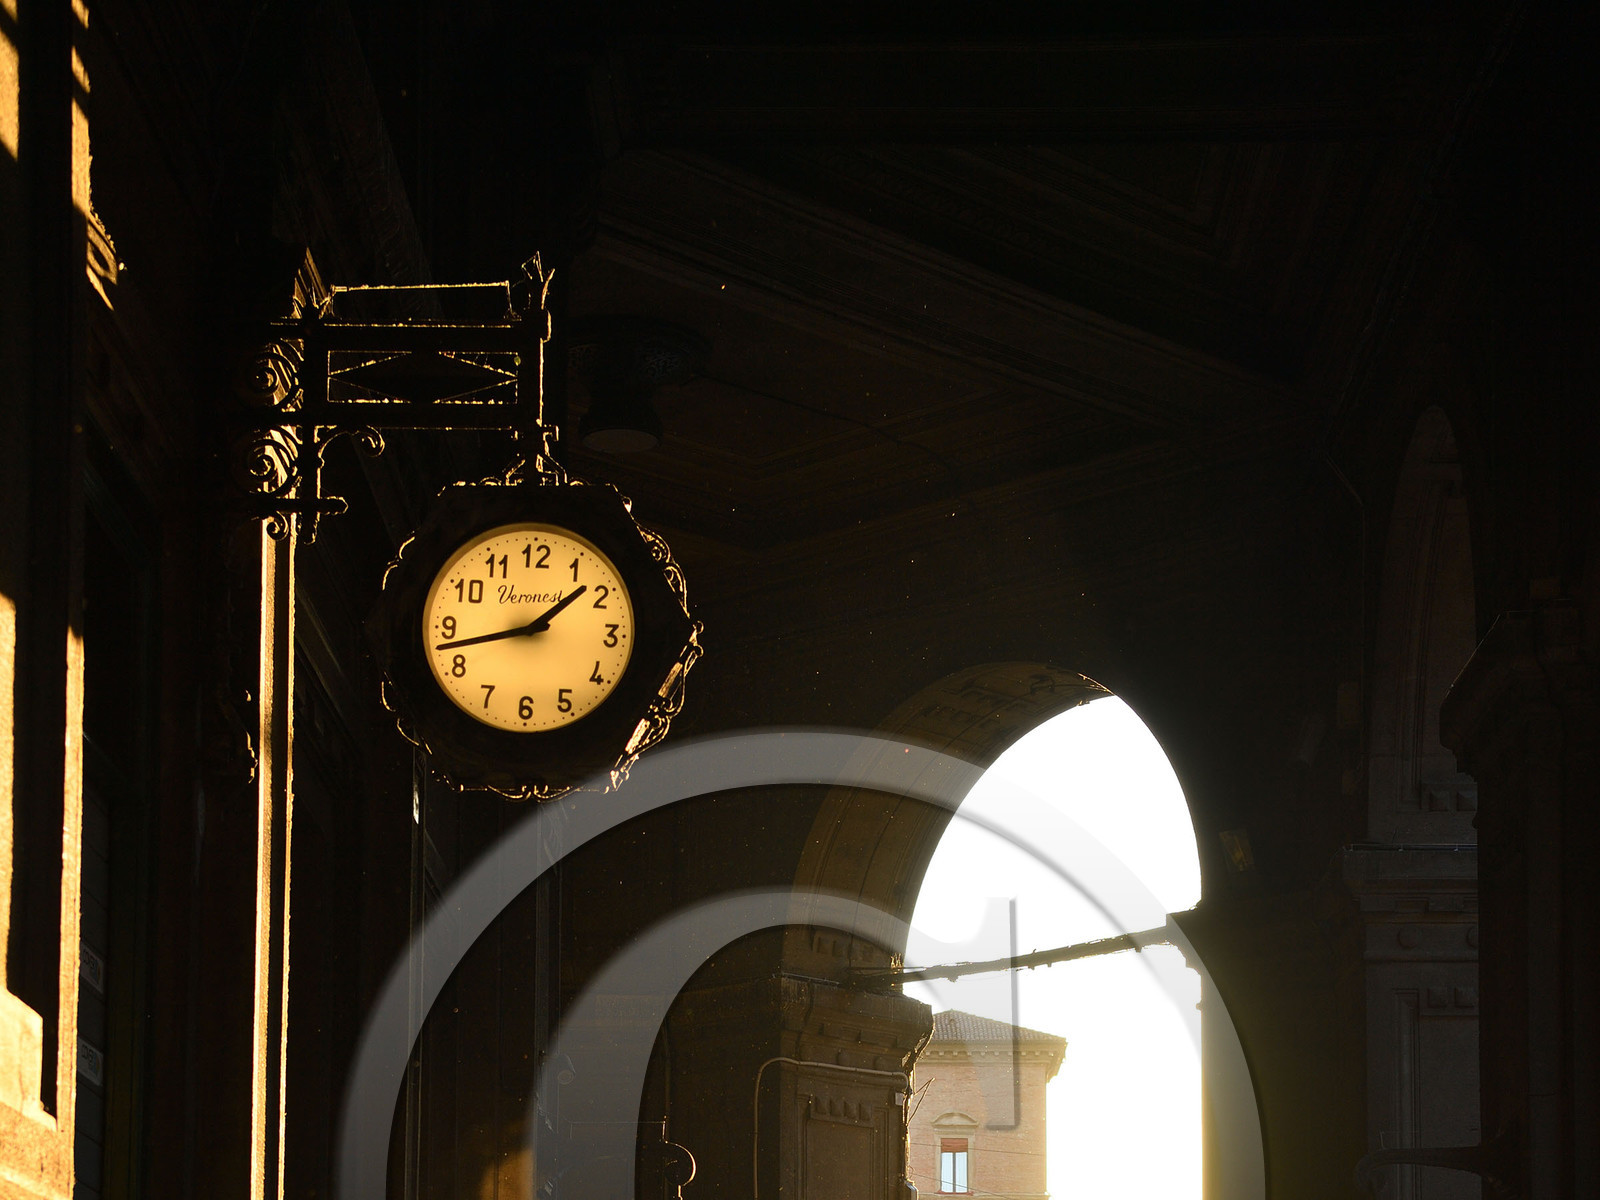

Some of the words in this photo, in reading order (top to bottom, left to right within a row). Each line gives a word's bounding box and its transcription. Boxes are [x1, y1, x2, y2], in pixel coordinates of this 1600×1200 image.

[485, 553, 508, 578] 11
[521, 543, 551, 568] 12
[569, 558, 579, 582] 1
[455, 579, 484, 603] 10
[592, 585, 609, 609] 2
[441, 615, 456, 640] 9
[603, 623, 619, 648] 3
[452, 654, 466, 678] 8
[589, 661, 604, 685] 4
[480, 684, 495, 709] 7
[519, 695, 534, 720] 6
[557, 688, 573, 713] 5
